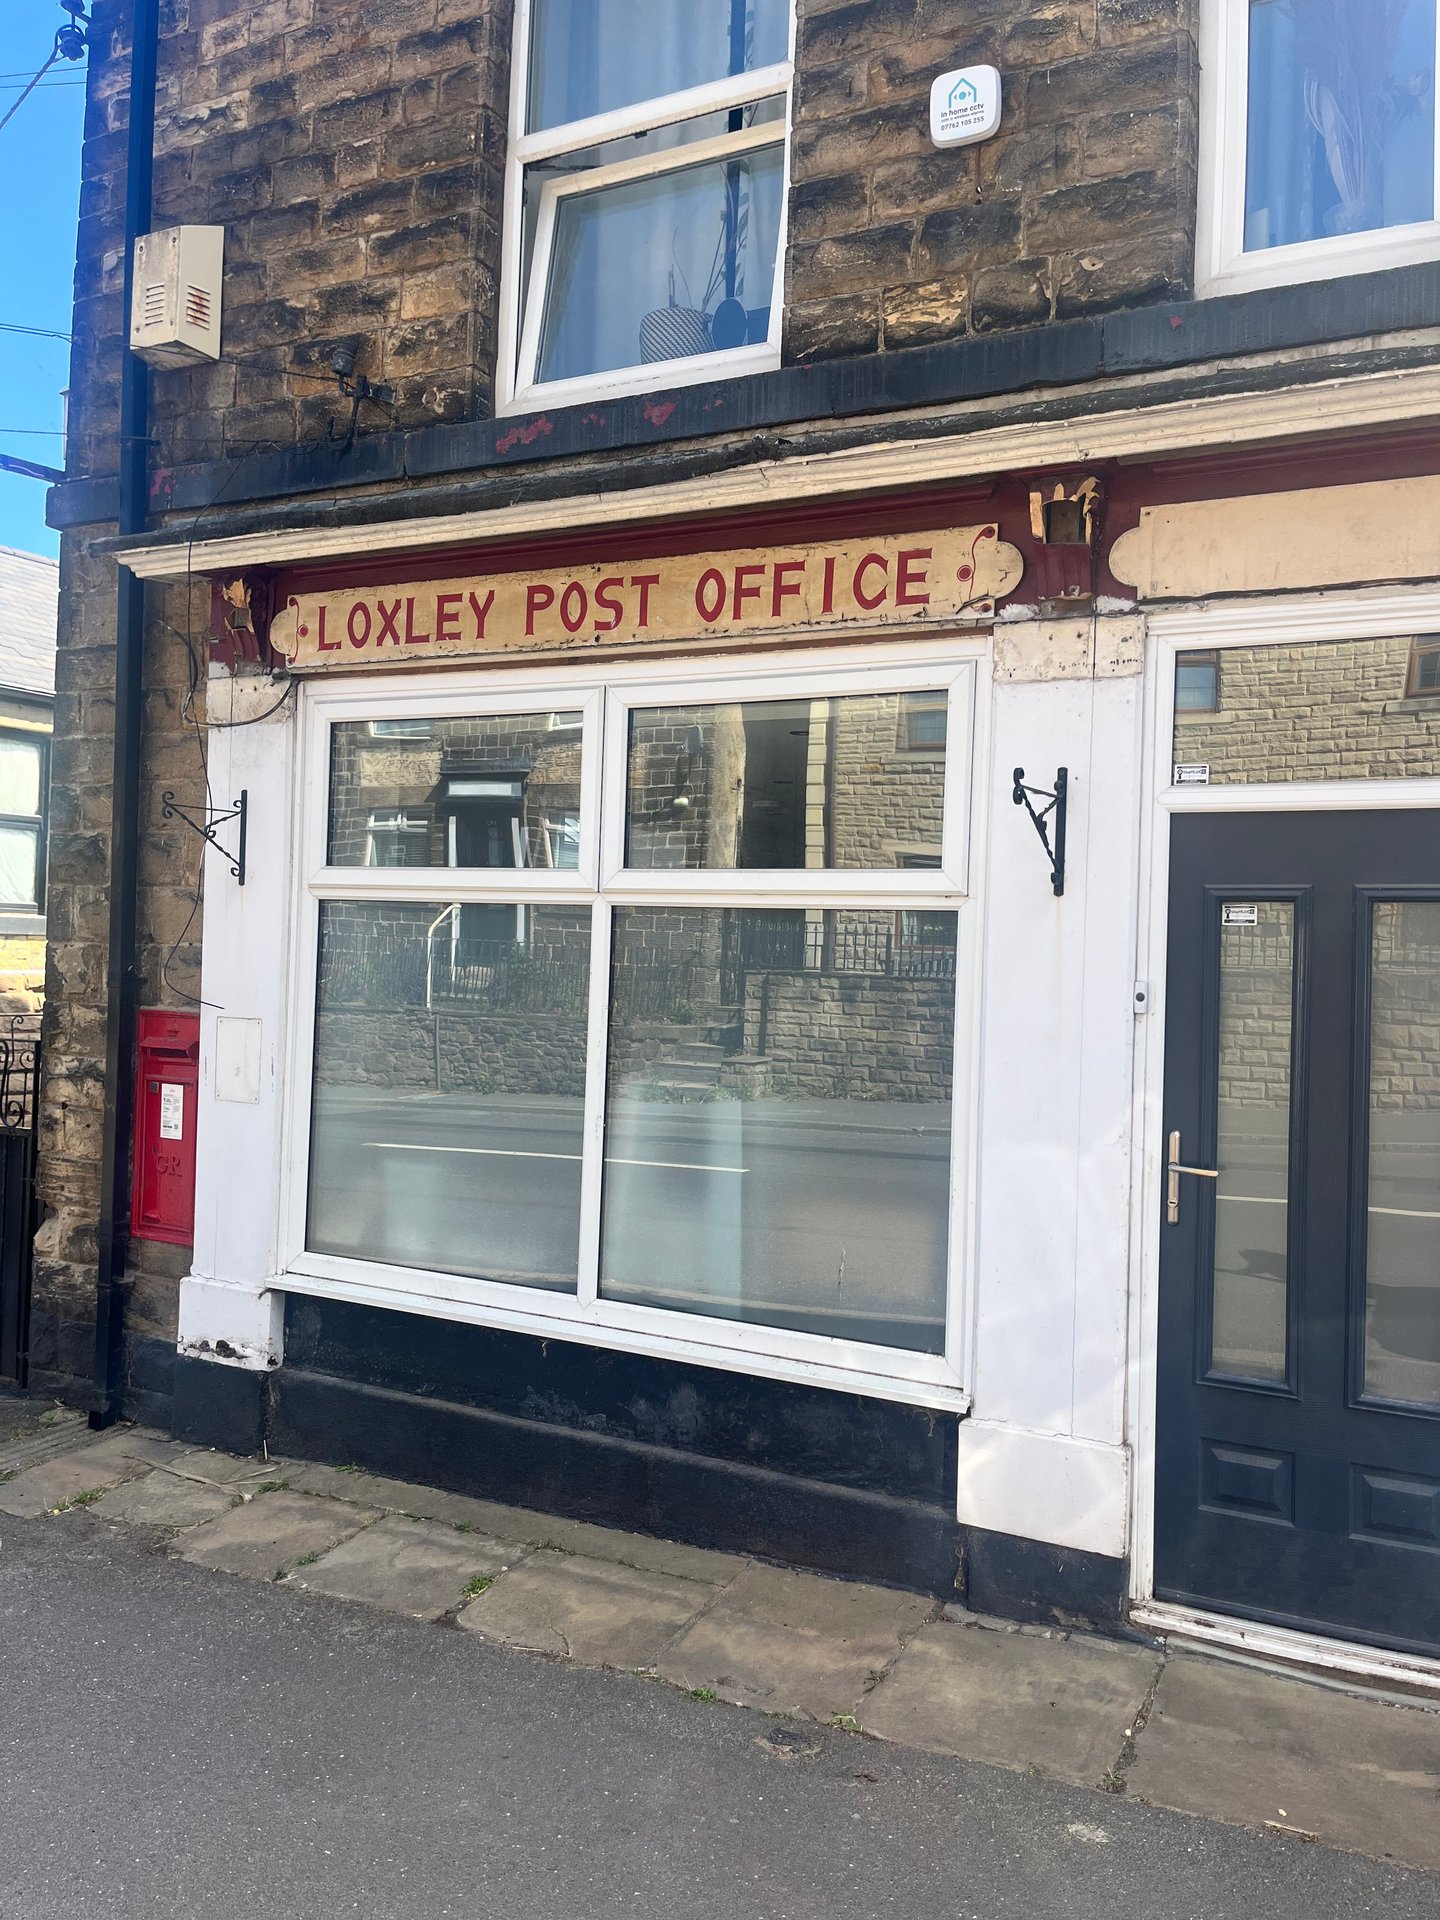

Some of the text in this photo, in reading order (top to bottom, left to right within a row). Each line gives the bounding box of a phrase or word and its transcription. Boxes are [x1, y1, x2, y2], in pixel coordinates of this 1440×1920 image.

[948, 107, 969, 116] home
[969, 103, 985, 112] cctv
[940, 121, 960, 130] 07762
[961, 118, 972, 126] 105
[317, 547, 933, 652] LOXLEY POST OFFICE
[156, 1153, 182, 1177] GR
